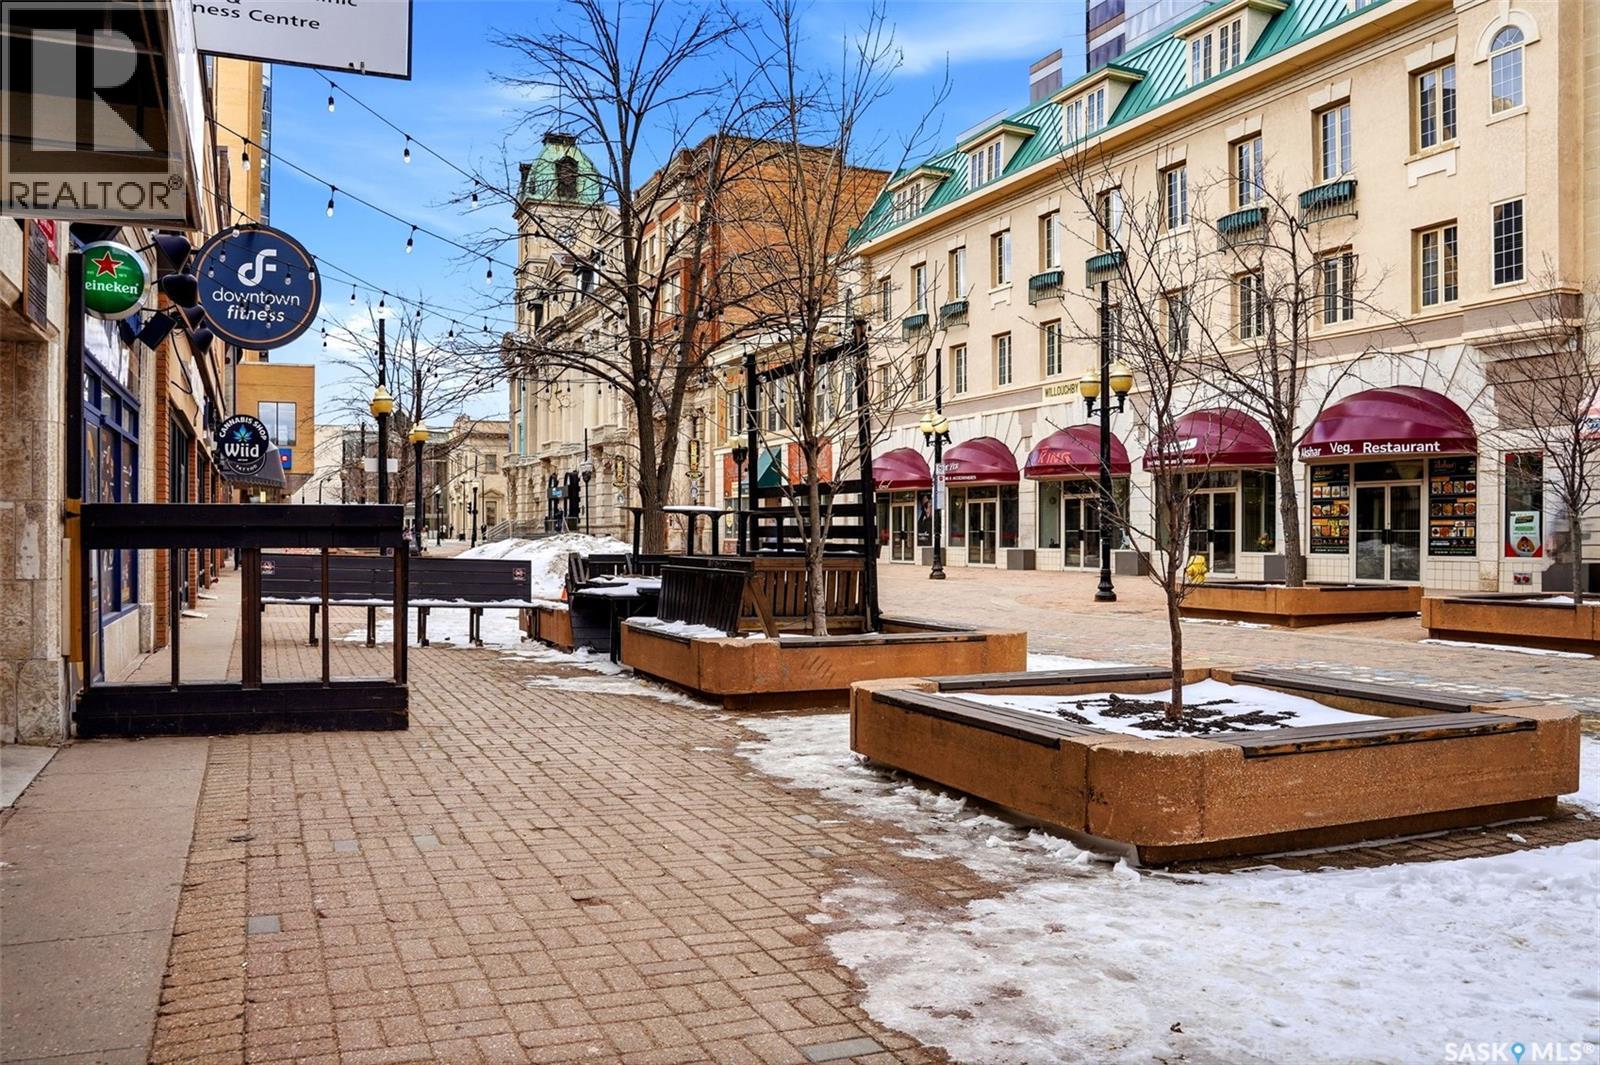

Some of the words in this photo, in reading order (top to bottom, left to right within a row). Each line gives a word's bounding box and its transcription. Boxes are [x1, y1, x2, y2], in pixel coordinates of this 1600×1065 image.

[192, 3, 240, 19] ness
[248, 9, 320, 30] Centre
[85, 280, 139, 294] eineken
[212, 287, 300, 306] downtown
[227, 304, 285, 322] fitness
[219, 416, 253, 438] CANNABIS
[252, 421, 268, 441] SHOP
[224, 443, 260, 458] Wiid
[1329, 442, 1354, 455] Veg.
[1362, 441, 1441, 453] Restaurant
